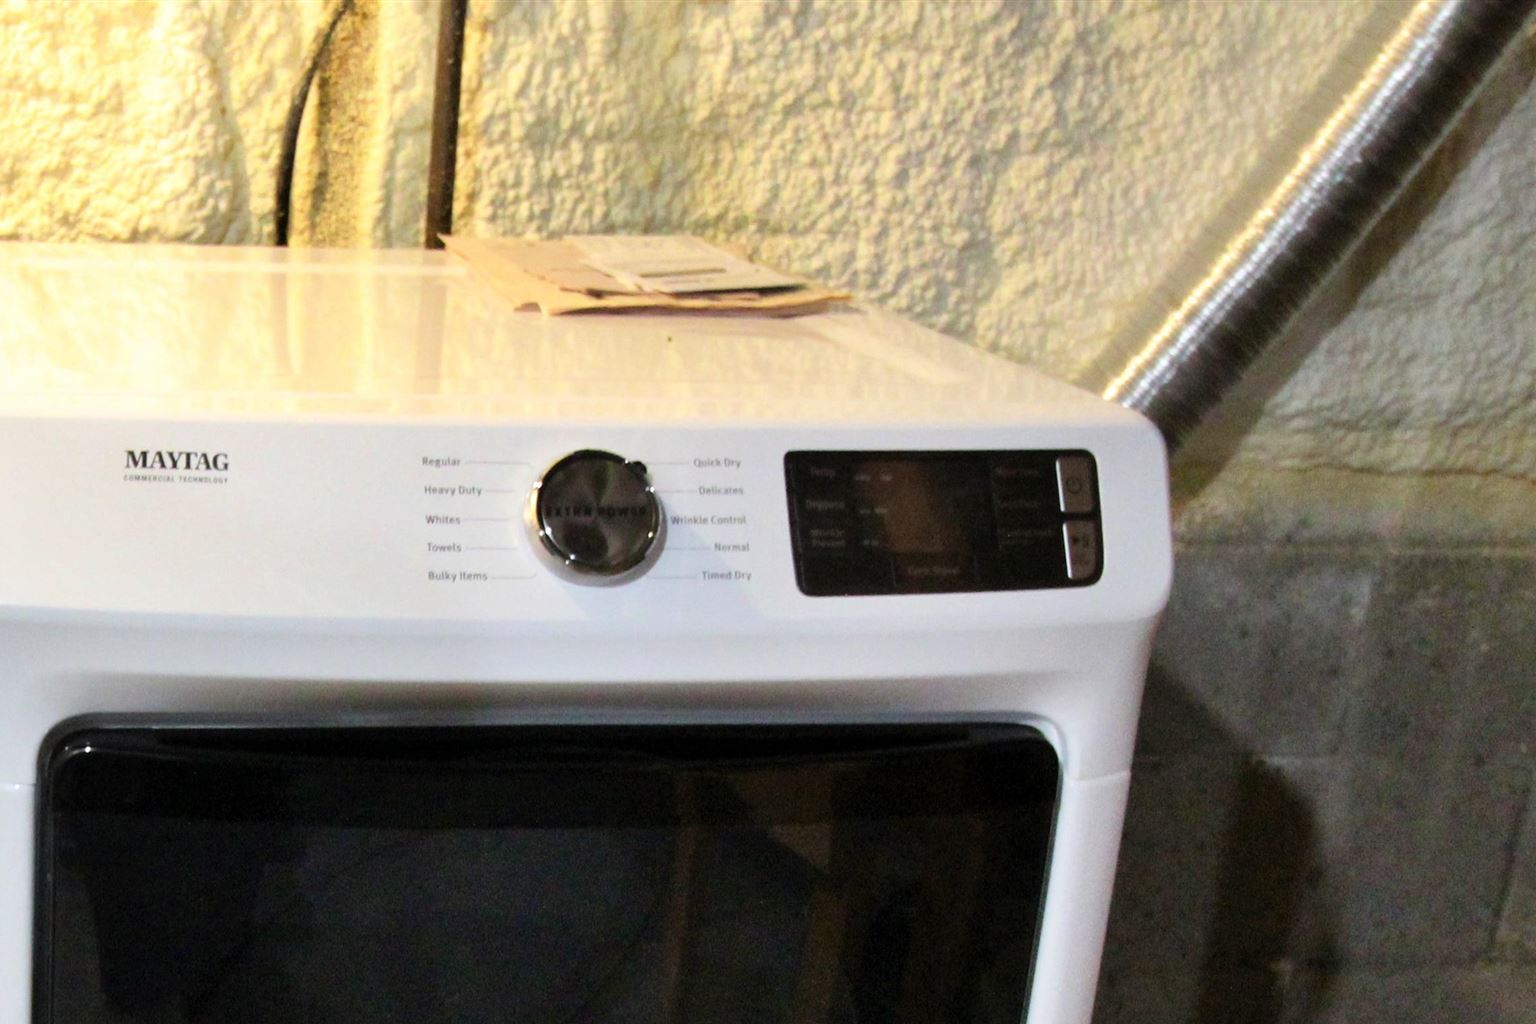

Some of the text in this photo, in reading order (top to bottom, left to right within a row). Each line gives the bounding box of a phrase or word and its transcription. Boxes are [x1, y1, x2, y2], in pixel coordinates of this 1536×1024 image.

[124, 450, 230, 471] MAYTAG
[421, 456, 461, 468] Regular
[693, 458, 742, 469] Quick Dry
[123, 474, 229, 484] COMMERCIAL TECHNOLOGY
[424, 485, 482, 497] Heavy Duty
[698, 486, 744, 495] Delicates
[424, 515, 461, 525] Whites
[670, 515, 747, 525] Wrinkle Control
[426, 543, 462, 553] Towels
[714, 543, 750, 552] Normal
[428, 571, 488, 583] Bulky Items
[701, 570, 752, 581] Timed Dry
